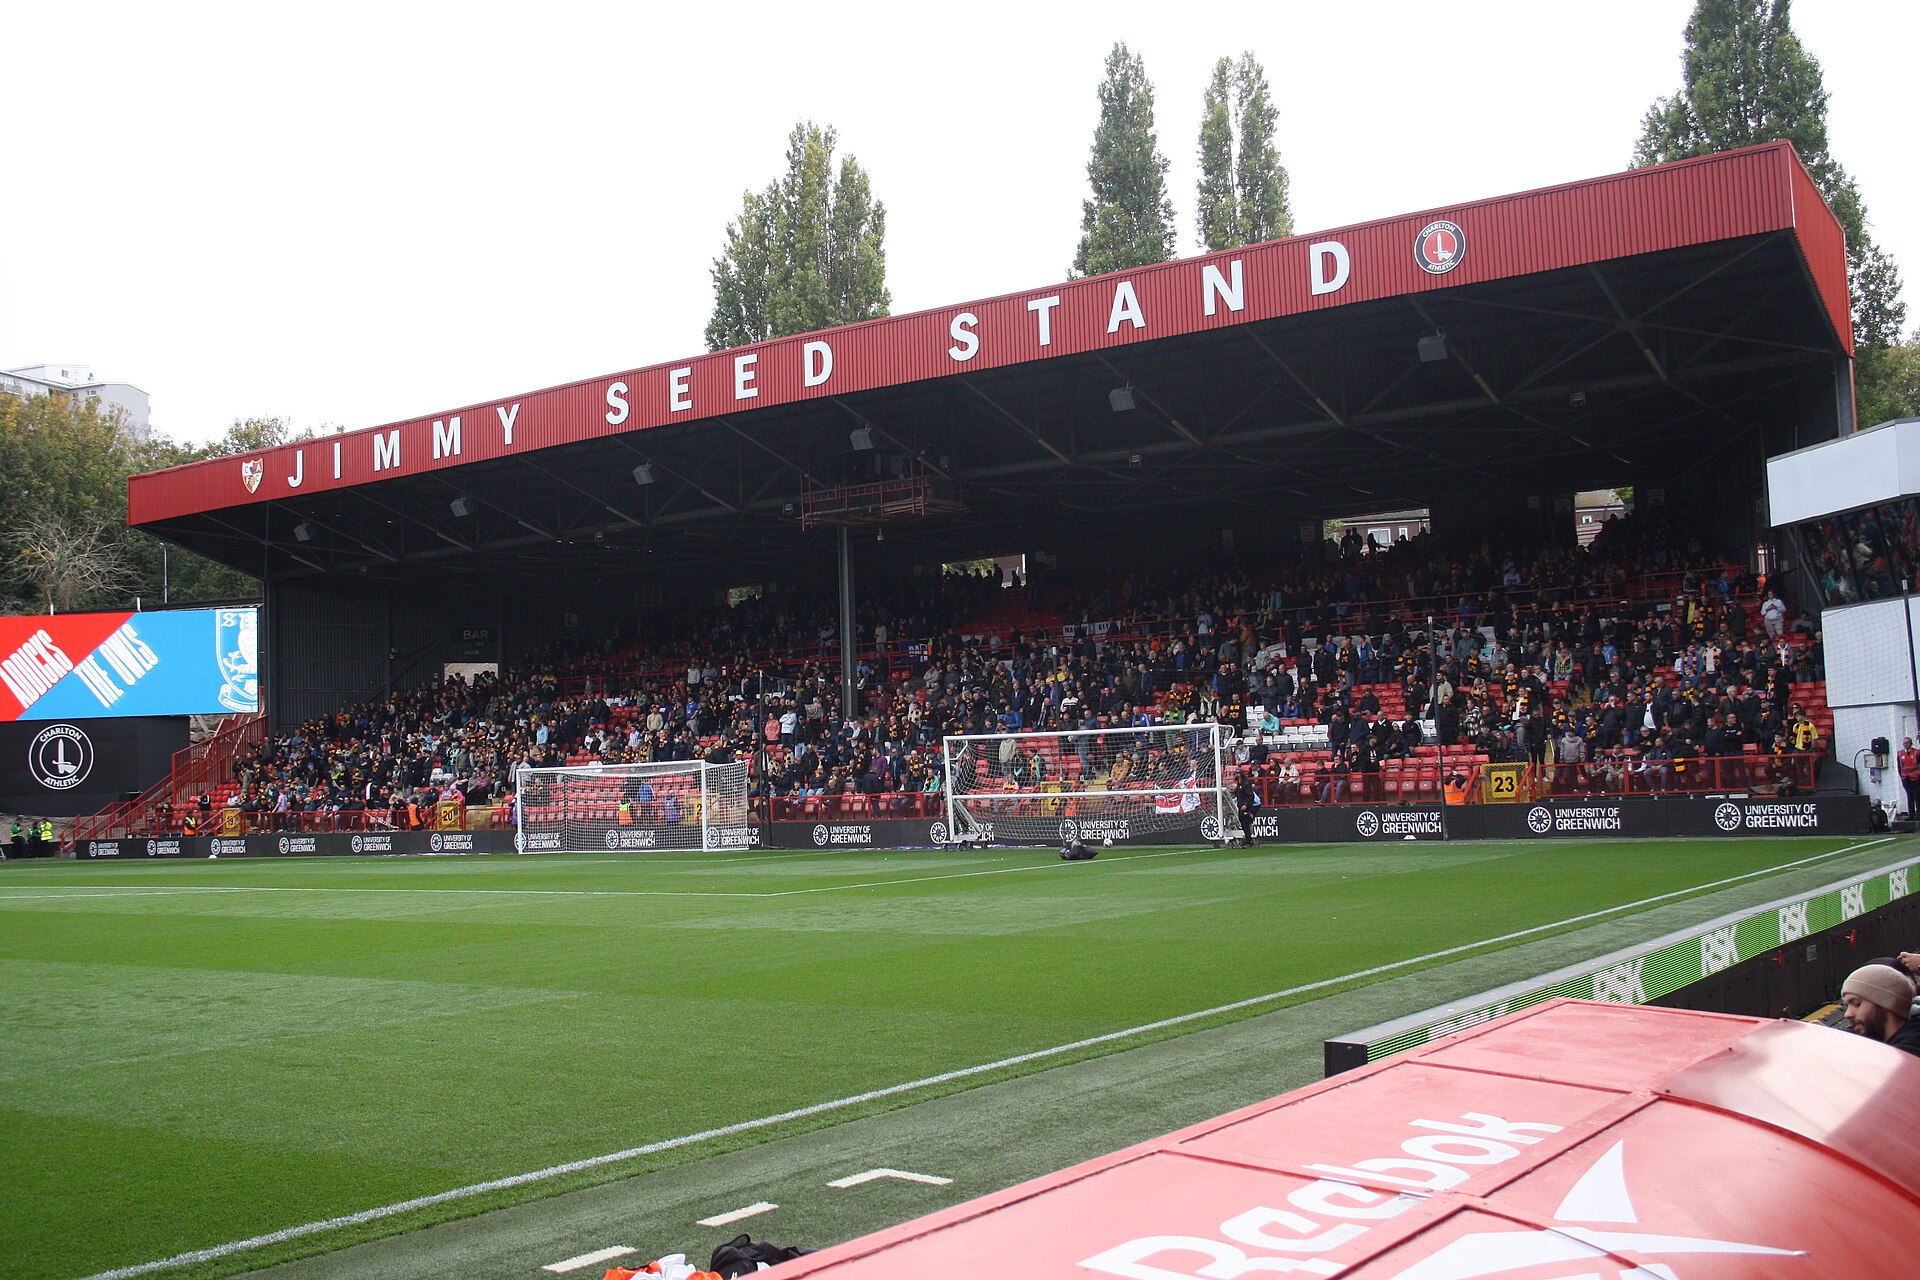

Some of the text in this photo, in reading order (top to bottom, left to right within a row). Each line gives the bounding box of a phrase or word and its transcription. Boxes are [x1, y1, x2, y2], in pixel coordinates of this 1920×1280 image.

[1422, 223, 1456, 238] CHARLTON
[287, 241, 1351, 488] JIMMY SEED STAND
[463, 629, 489, 640] BAR
[0, 629, 73, 709] ADDICKS
[73, 623, 159, 708] THE OWLS
[39, 727, 82, 743] CHARLTON
[44, 776, 79, 787] ATHLETIC
[1494, 777, 1515, 793] 23
[1555, 808, 1619, 818] UNIVERSITY OF
[1745, 804, 1816, 815] UNIVERSITY OF
[442, 811, 453, 822] 20
[1382, 812, 1440, 822] UNIVERSITY OF
[1746, 815, 1817, 828] GREENWICH
[1080, 820, 1128, 830] UNIVERSITY OF
[1382, 822, 1441, 833] GREENWICH
[1555, 818, 1620, 830] GREENWICH
[721, 835, 759, 845] GREENWICH
[830, 834, 871, 843] GREENWICH
[1080, 829, 1129, 839] GREENWICH
[528, 840, 560, 848] GREENWICH
[620, 838, 655, 847] GREENWICH
[1889, 867, 1909, 901] RSK
[1841, 883, 1865, 921] RSK
[1779, 901, 1809, 944] RSK
[1700, 924, 1739, 977] RSK
[1592, 957, 1648, 1005] RSK
[1076, 1111, 1565, 1280] Reebok
